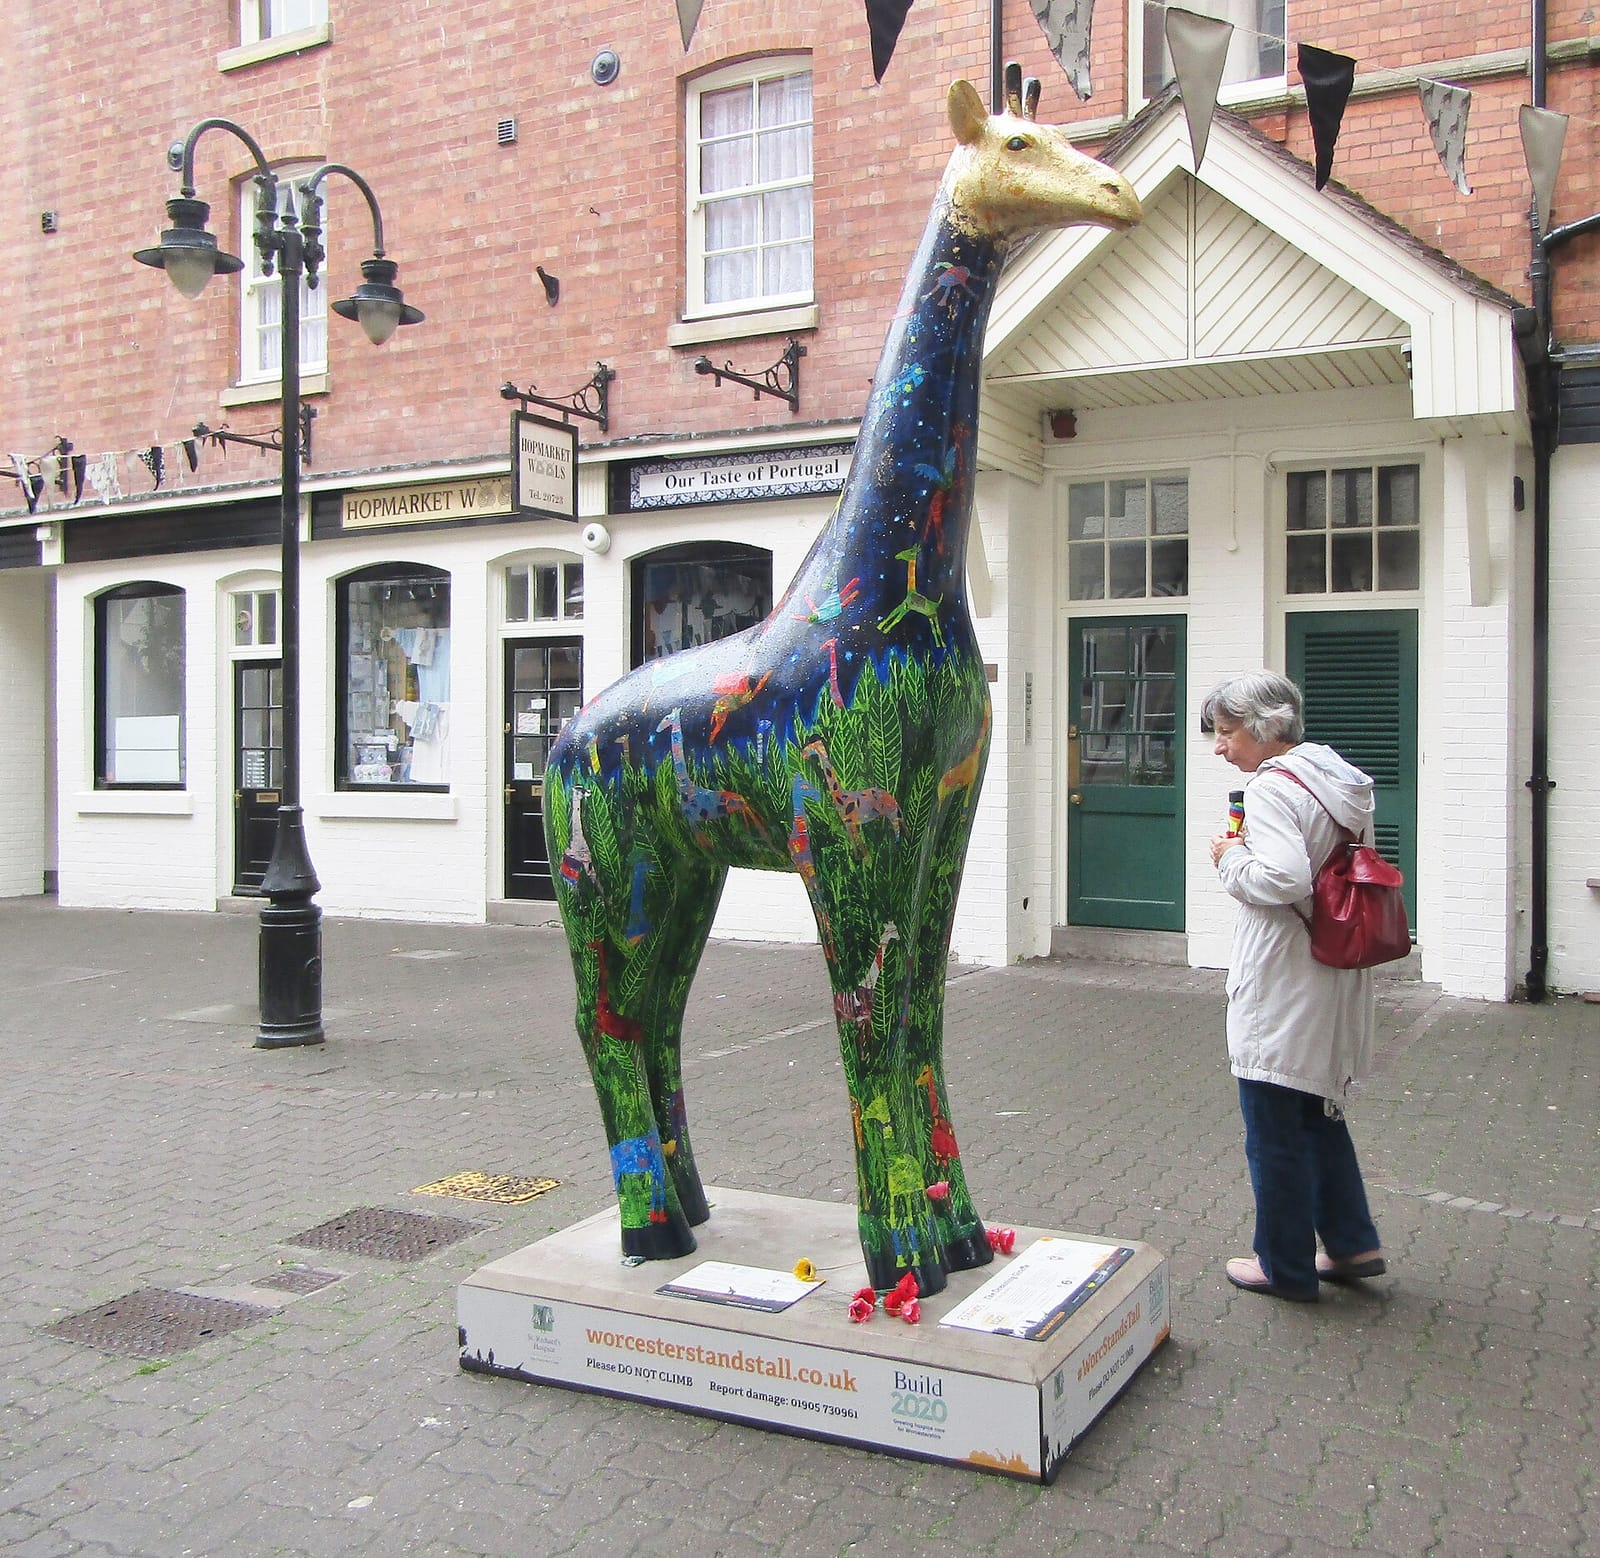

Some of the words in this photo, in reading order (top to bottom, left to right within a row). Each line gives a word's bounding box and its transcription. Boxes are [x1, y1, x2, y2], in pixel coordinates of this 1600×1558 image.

[521, 437, 571, 463] HOPMARKET
[665, 474, 695, 490] Our
[701, 470, 742, 486] Taste
[748, 466, 764, 481] of
[769, 458, 840, 479] Portugal
[346, 489, 453, 521] HOPMARKET
[1076, 1301, 1142, 1382] #WorcStandsTall
[585, 1327, 859, 1393] worcesterstandstall.co.uk
[586, 1358, 616, 1373] Please
[618, 1363, 633, 1376] DO
[634, 1367, 657, 1380] NOT
[658, 1371, 694, 1387] CLIMB
[1088, 1382, 1103, 1401] Please
[1102, 1373, 1110, 1386] DO
[1110, 1363, 1120, 1377] NOT
[1120, 1344, 1135, 1367] CLIMB
[709, 1381, 744, 1396] Report
[745, 1388, 789, 1407] damage:
[790, 1398, 821, 1413] 01905
[822, 1404, 859, 1419] 730961
[894, 1371, 943, 1397] Build
[890, 1391, 948, 1424] 2020
[893, 1418, 914, 1428] Growing
[914, 1422, 934, 1431] hospice
